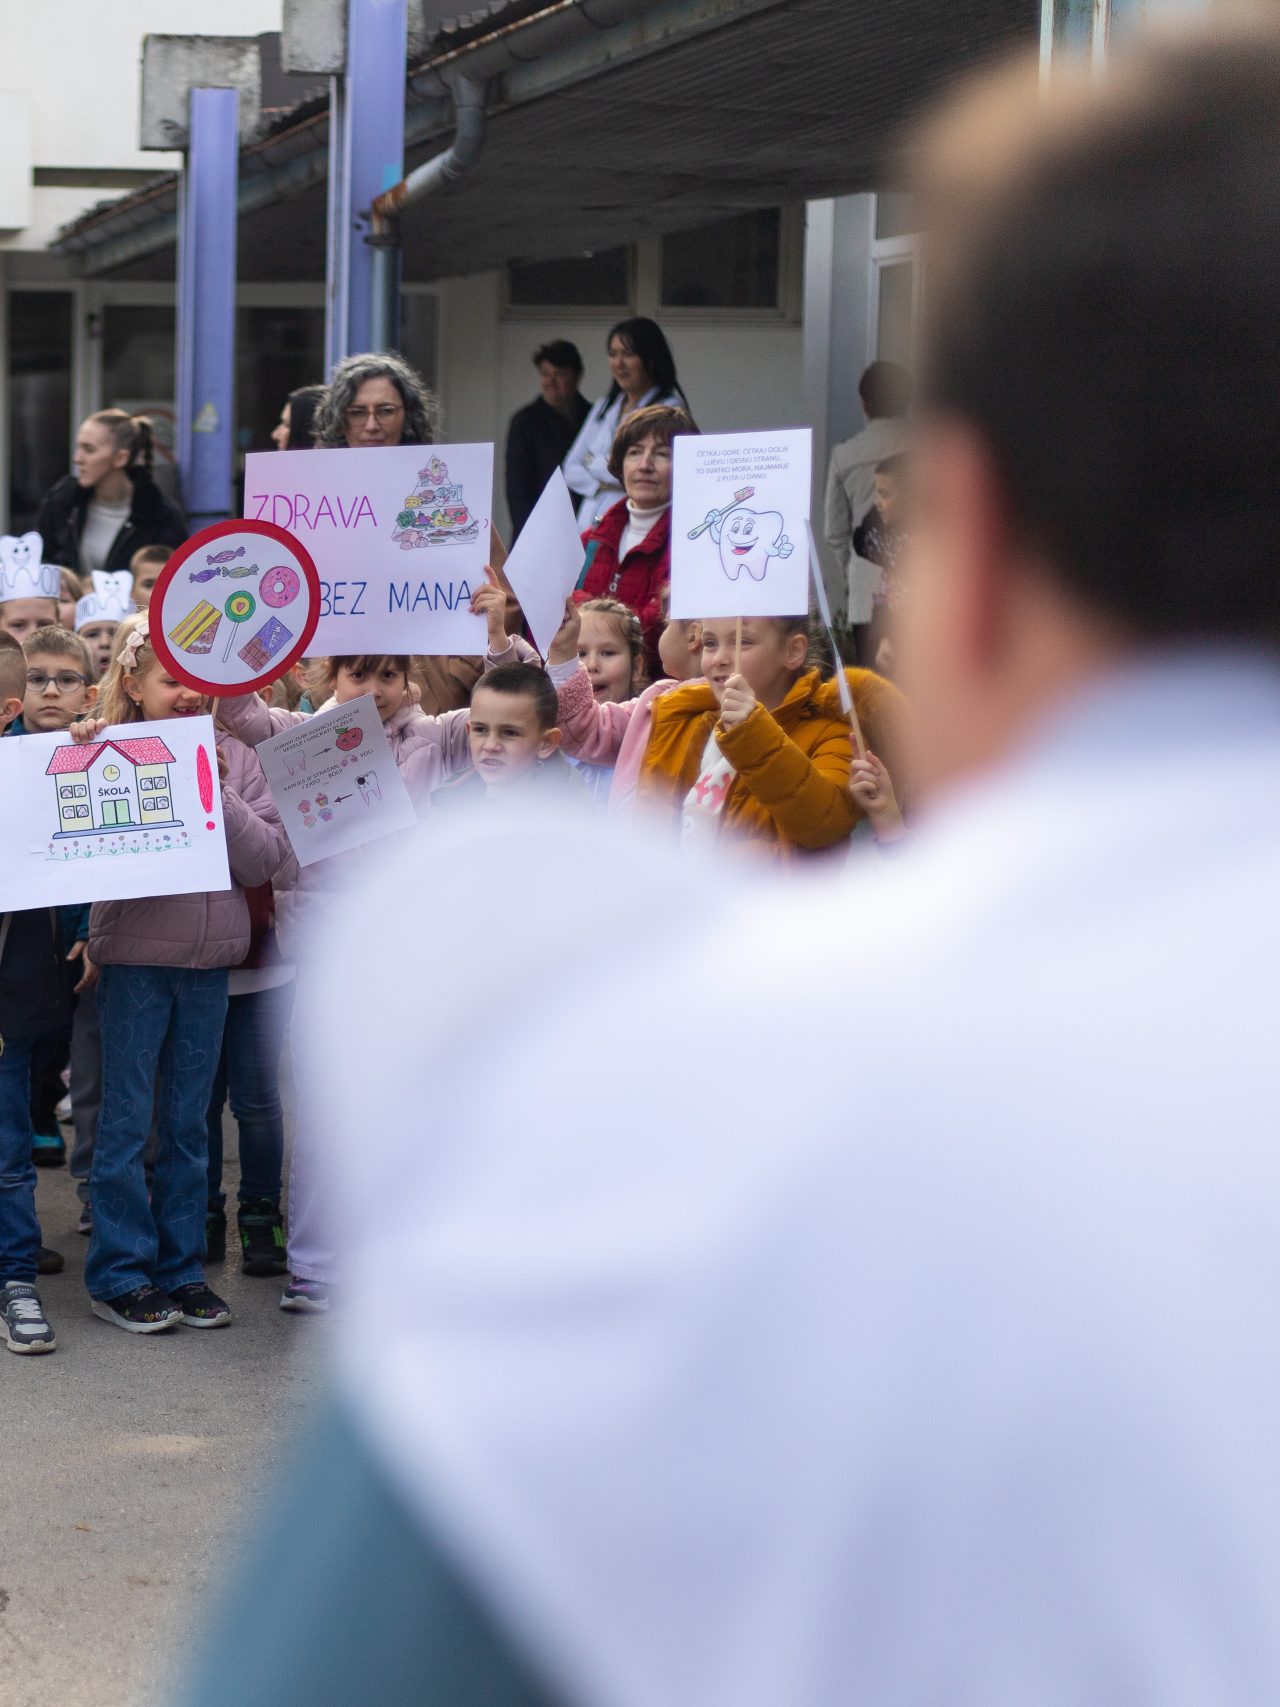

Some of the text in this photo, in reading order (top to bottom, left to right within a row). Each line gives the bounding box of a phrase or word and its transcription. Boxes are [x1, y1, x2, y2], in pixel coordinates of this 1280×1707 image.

[252, 493, 377, 530] ZDRAVA
[318, 580, 472, 617] BEZ MANA
[98, 787, 131, 797] ŠKOLA
